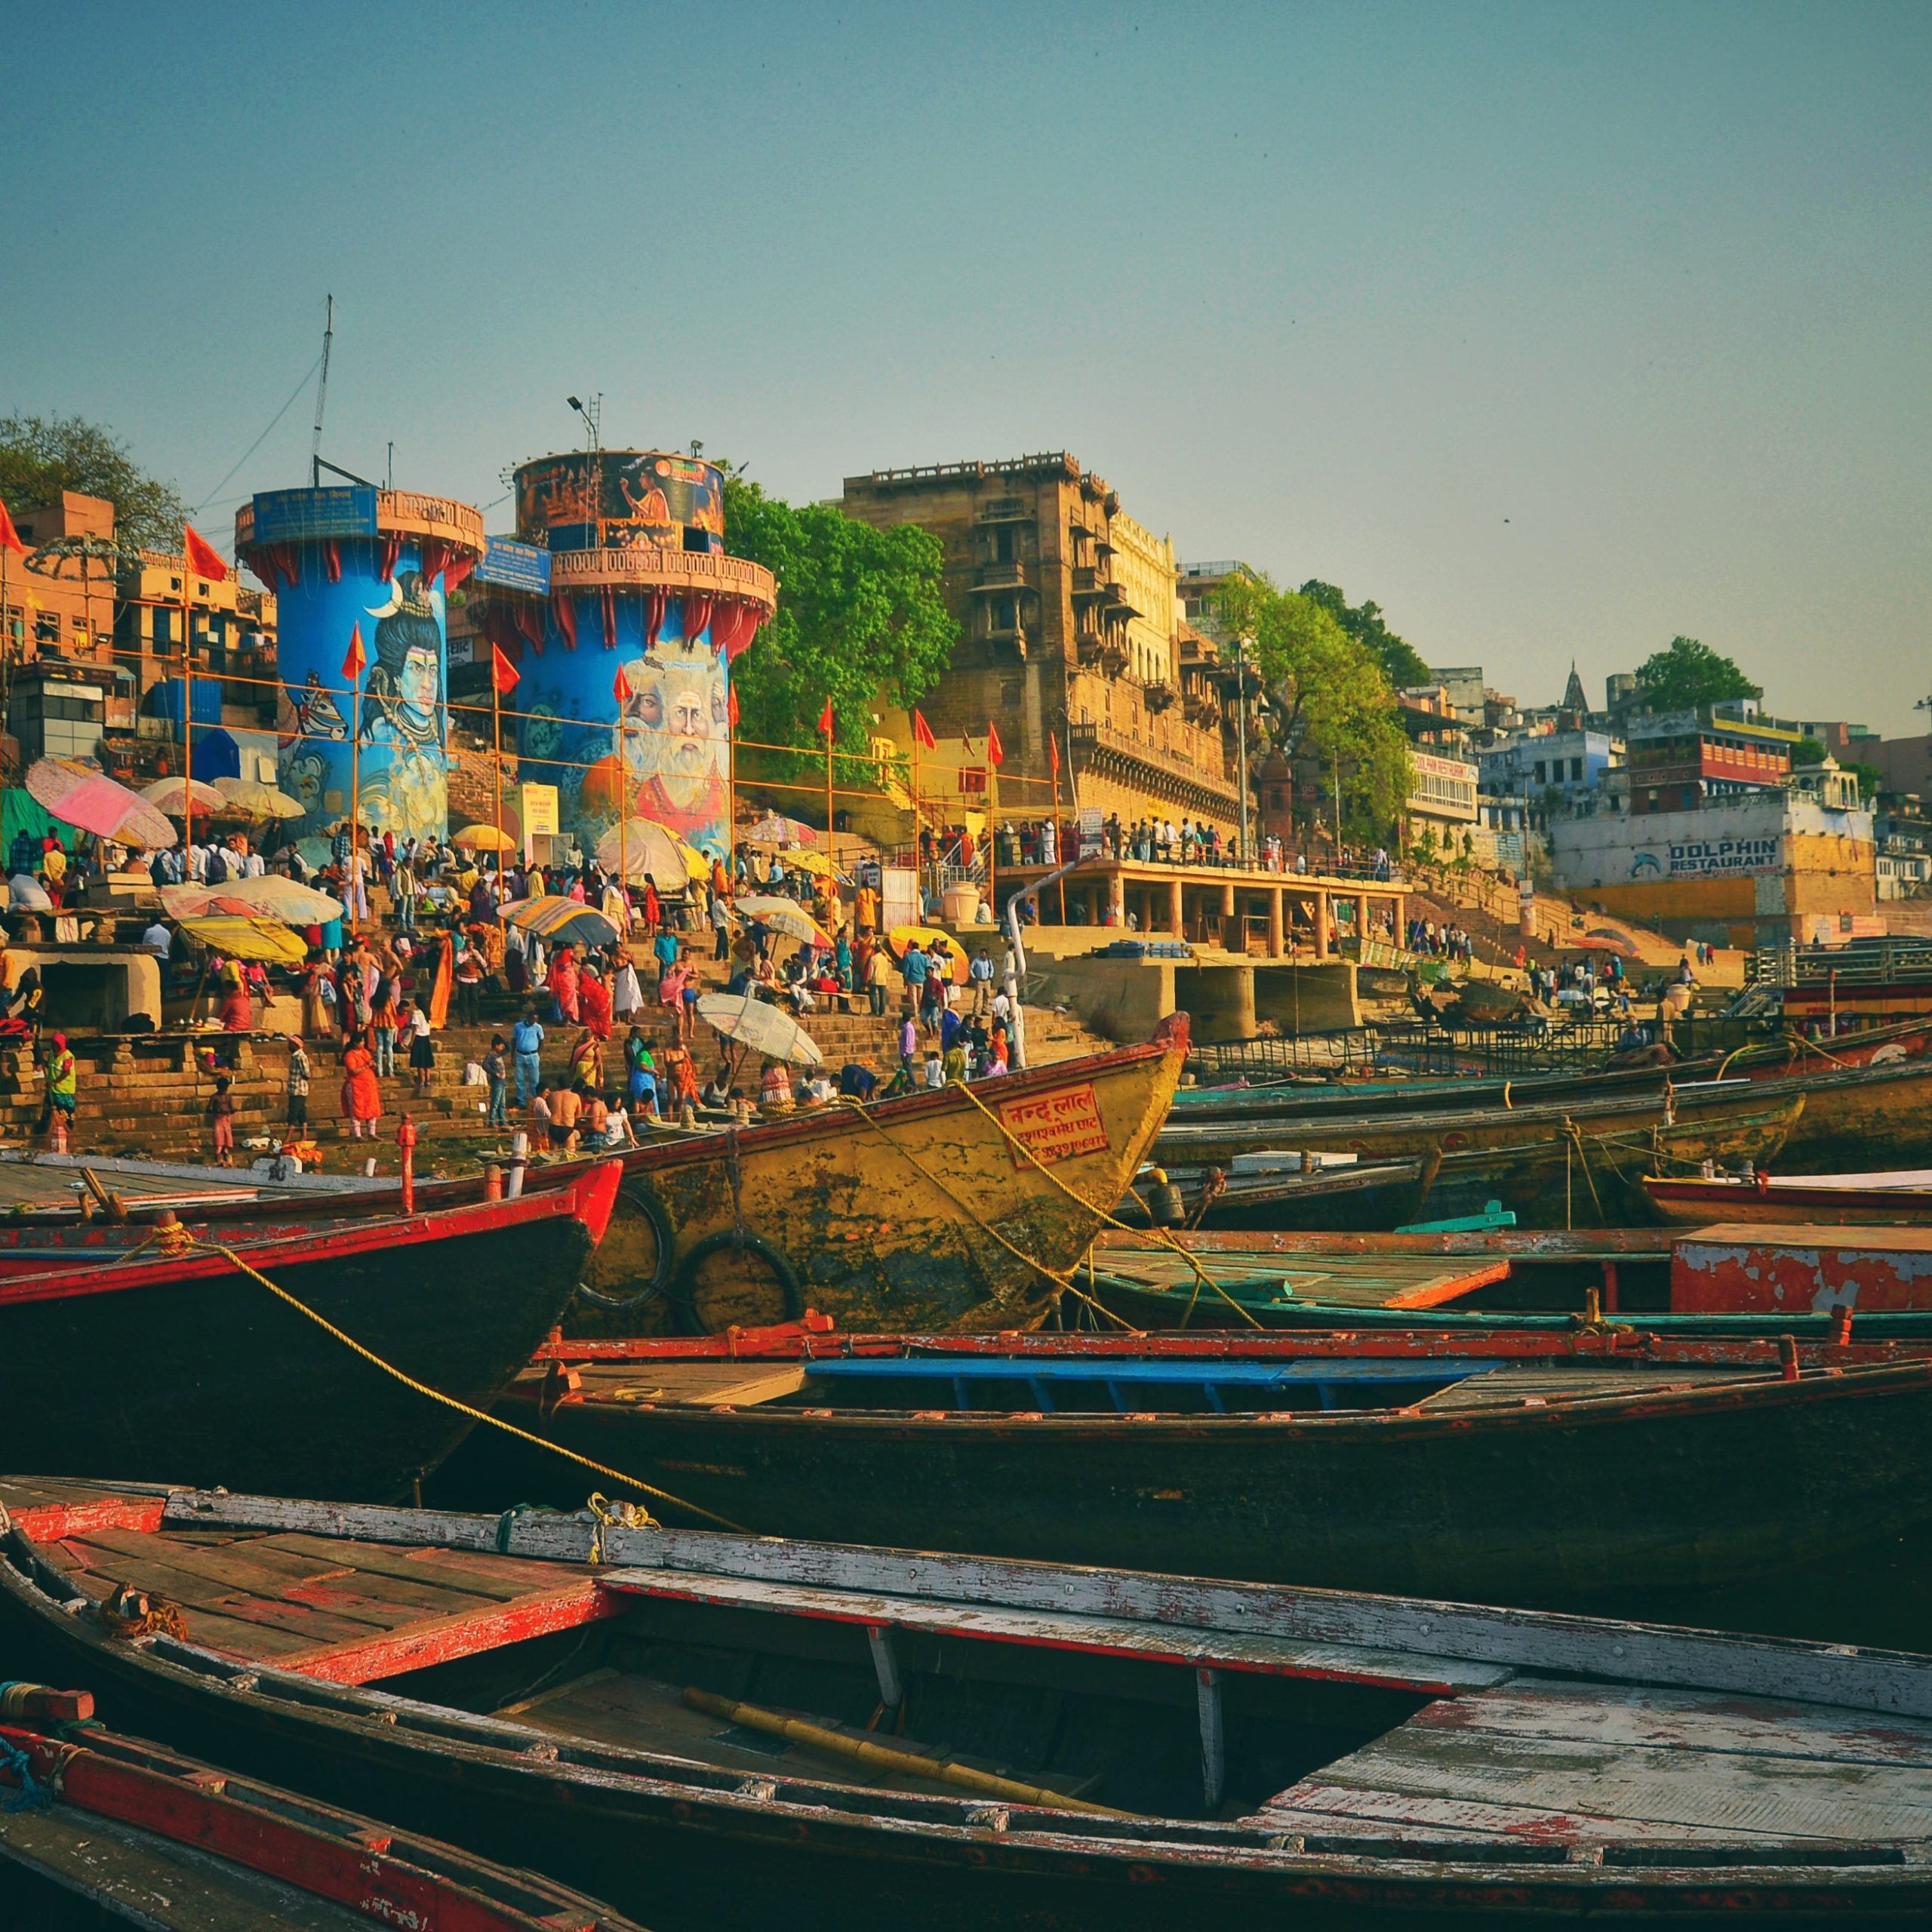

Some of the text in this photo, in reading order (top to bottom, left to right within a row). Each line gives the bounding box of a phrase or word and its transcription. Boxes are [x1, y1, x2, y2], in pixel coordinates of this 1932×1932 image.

[1670, 840, 1776, 860] DOLPHIN
[1670, 854, 1776, 871] RESTAURANT
[1051, 1091, 1093, 1115] लाल
